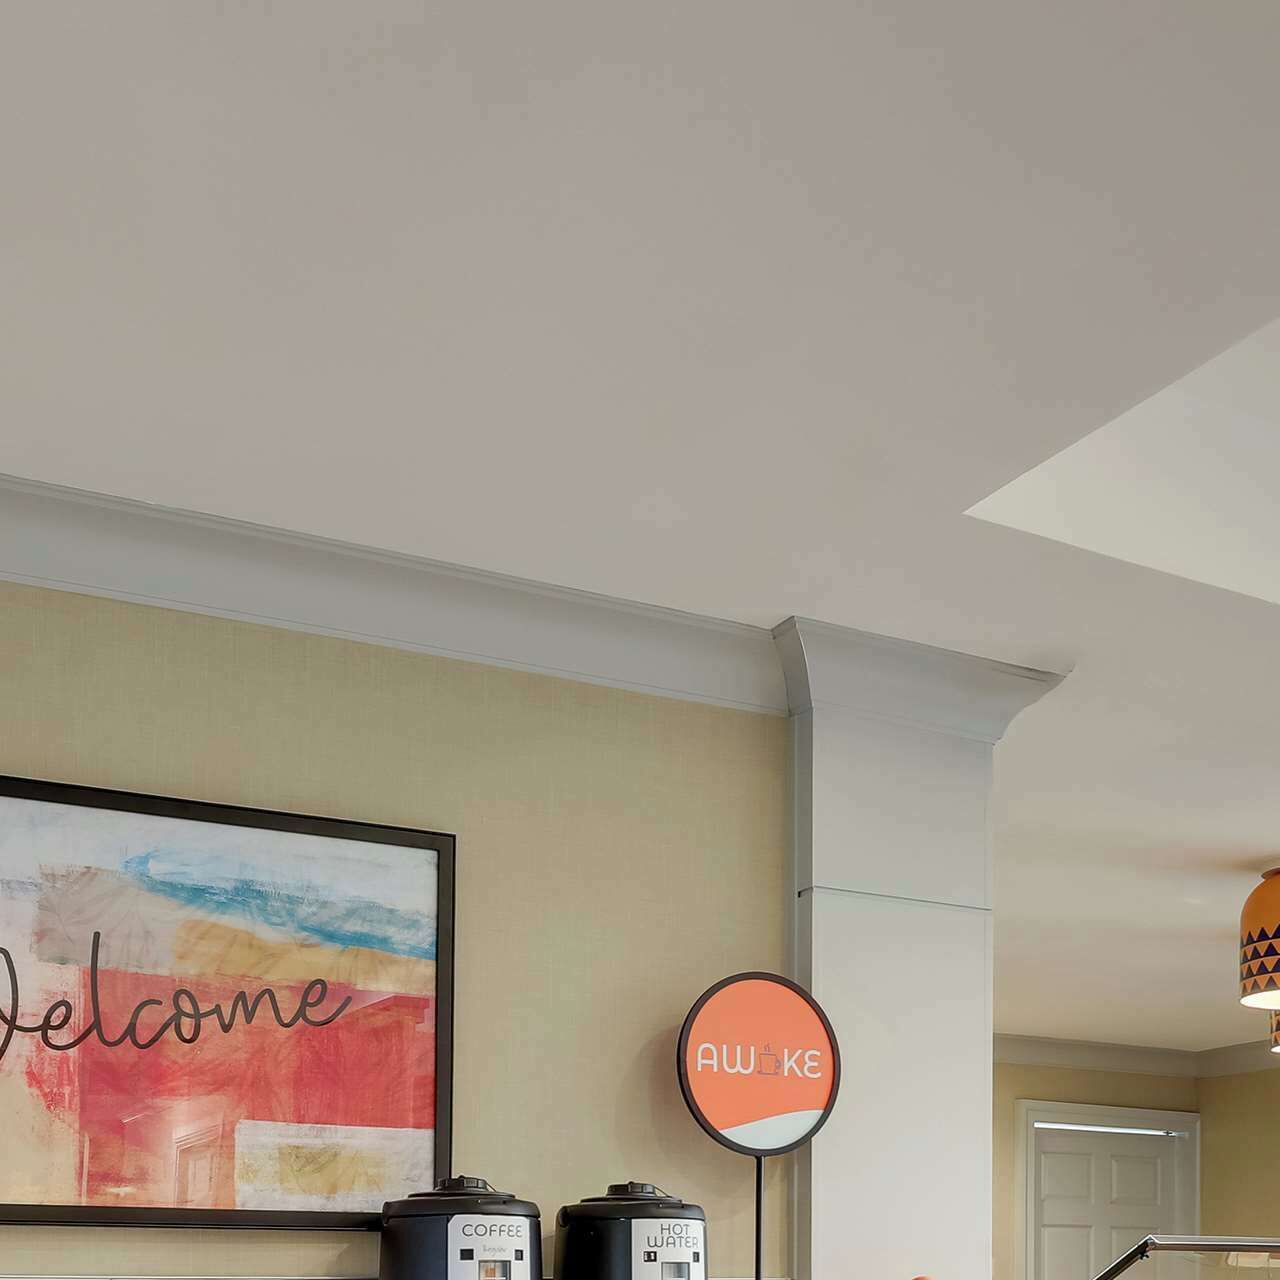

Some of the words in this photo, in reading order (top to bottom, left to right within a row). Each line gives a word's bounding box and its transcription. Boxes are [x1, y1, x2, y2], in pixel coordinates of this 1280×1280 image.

[461, 1223, 523, 1237] COFFEE
[660, 1223, 691, 1235] HOT
[646, 1235, 699, 1248] WATER
